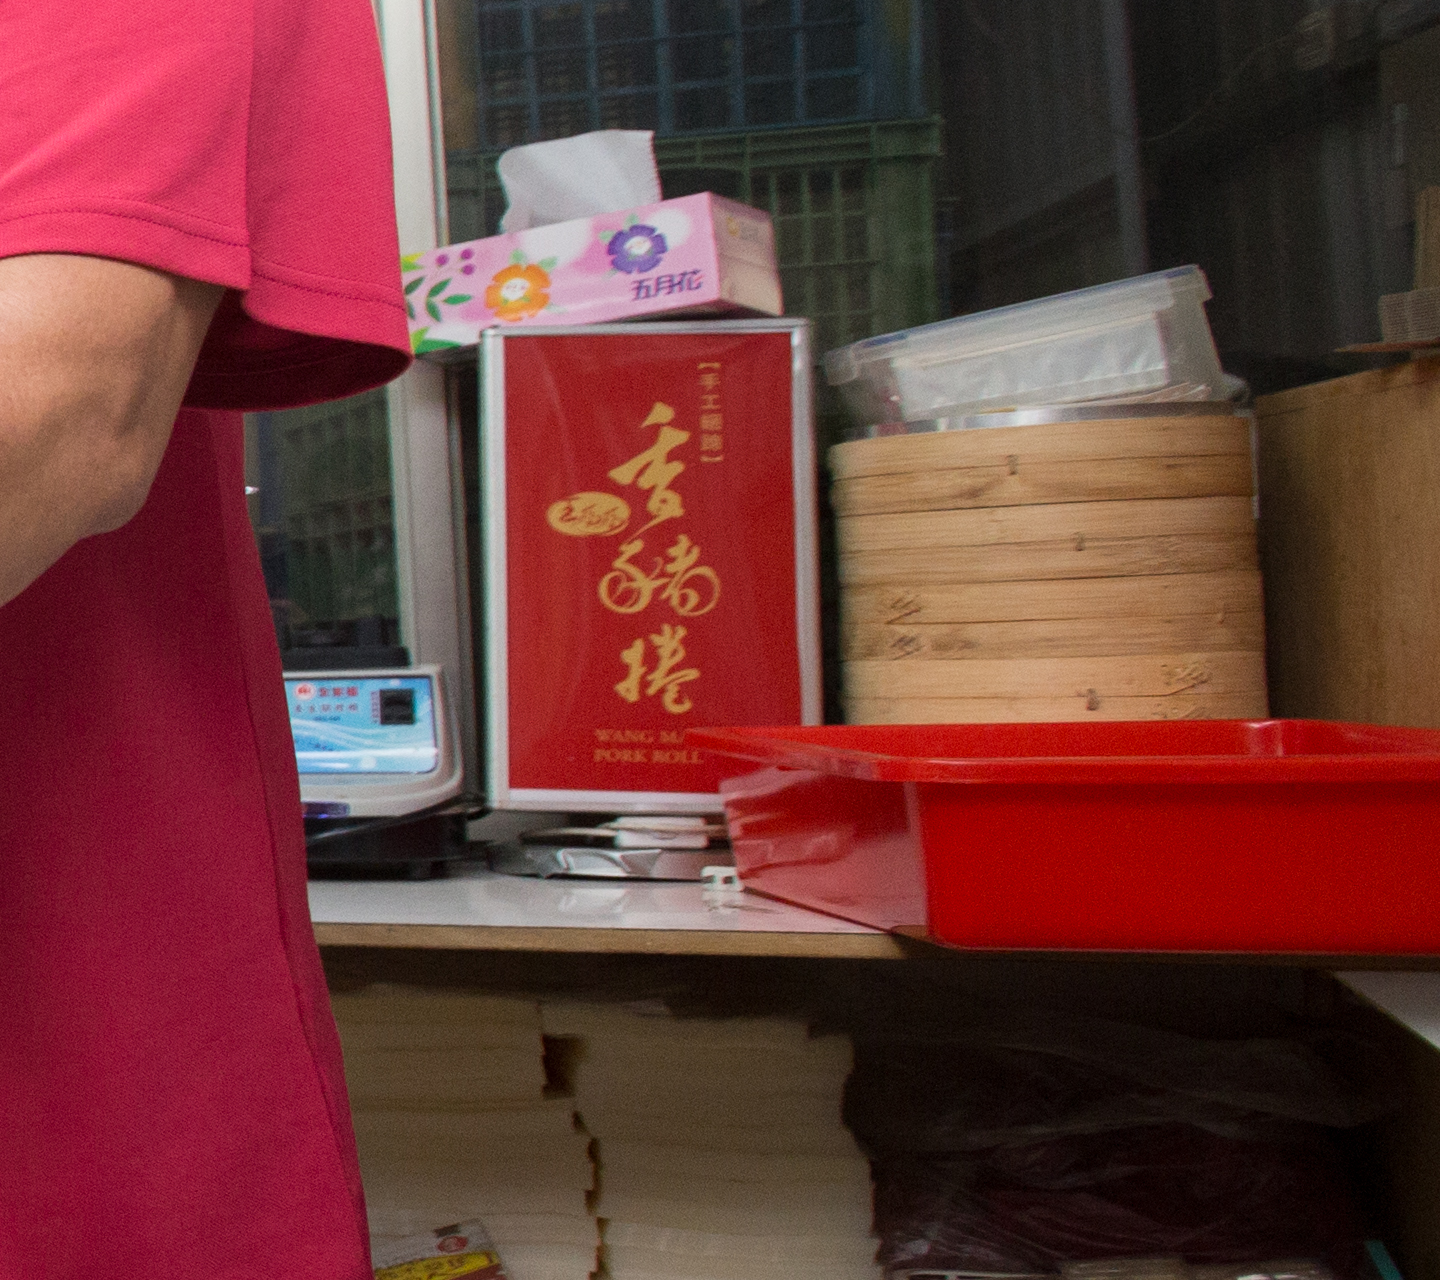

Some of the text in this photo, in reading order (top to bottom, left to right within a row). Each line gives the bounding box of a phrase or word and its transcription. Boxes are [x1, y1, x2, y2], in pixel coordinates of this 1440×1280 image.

[632, 269, 704, 301] 五月花
[593, 748, 705, 765] PORK ROLL
